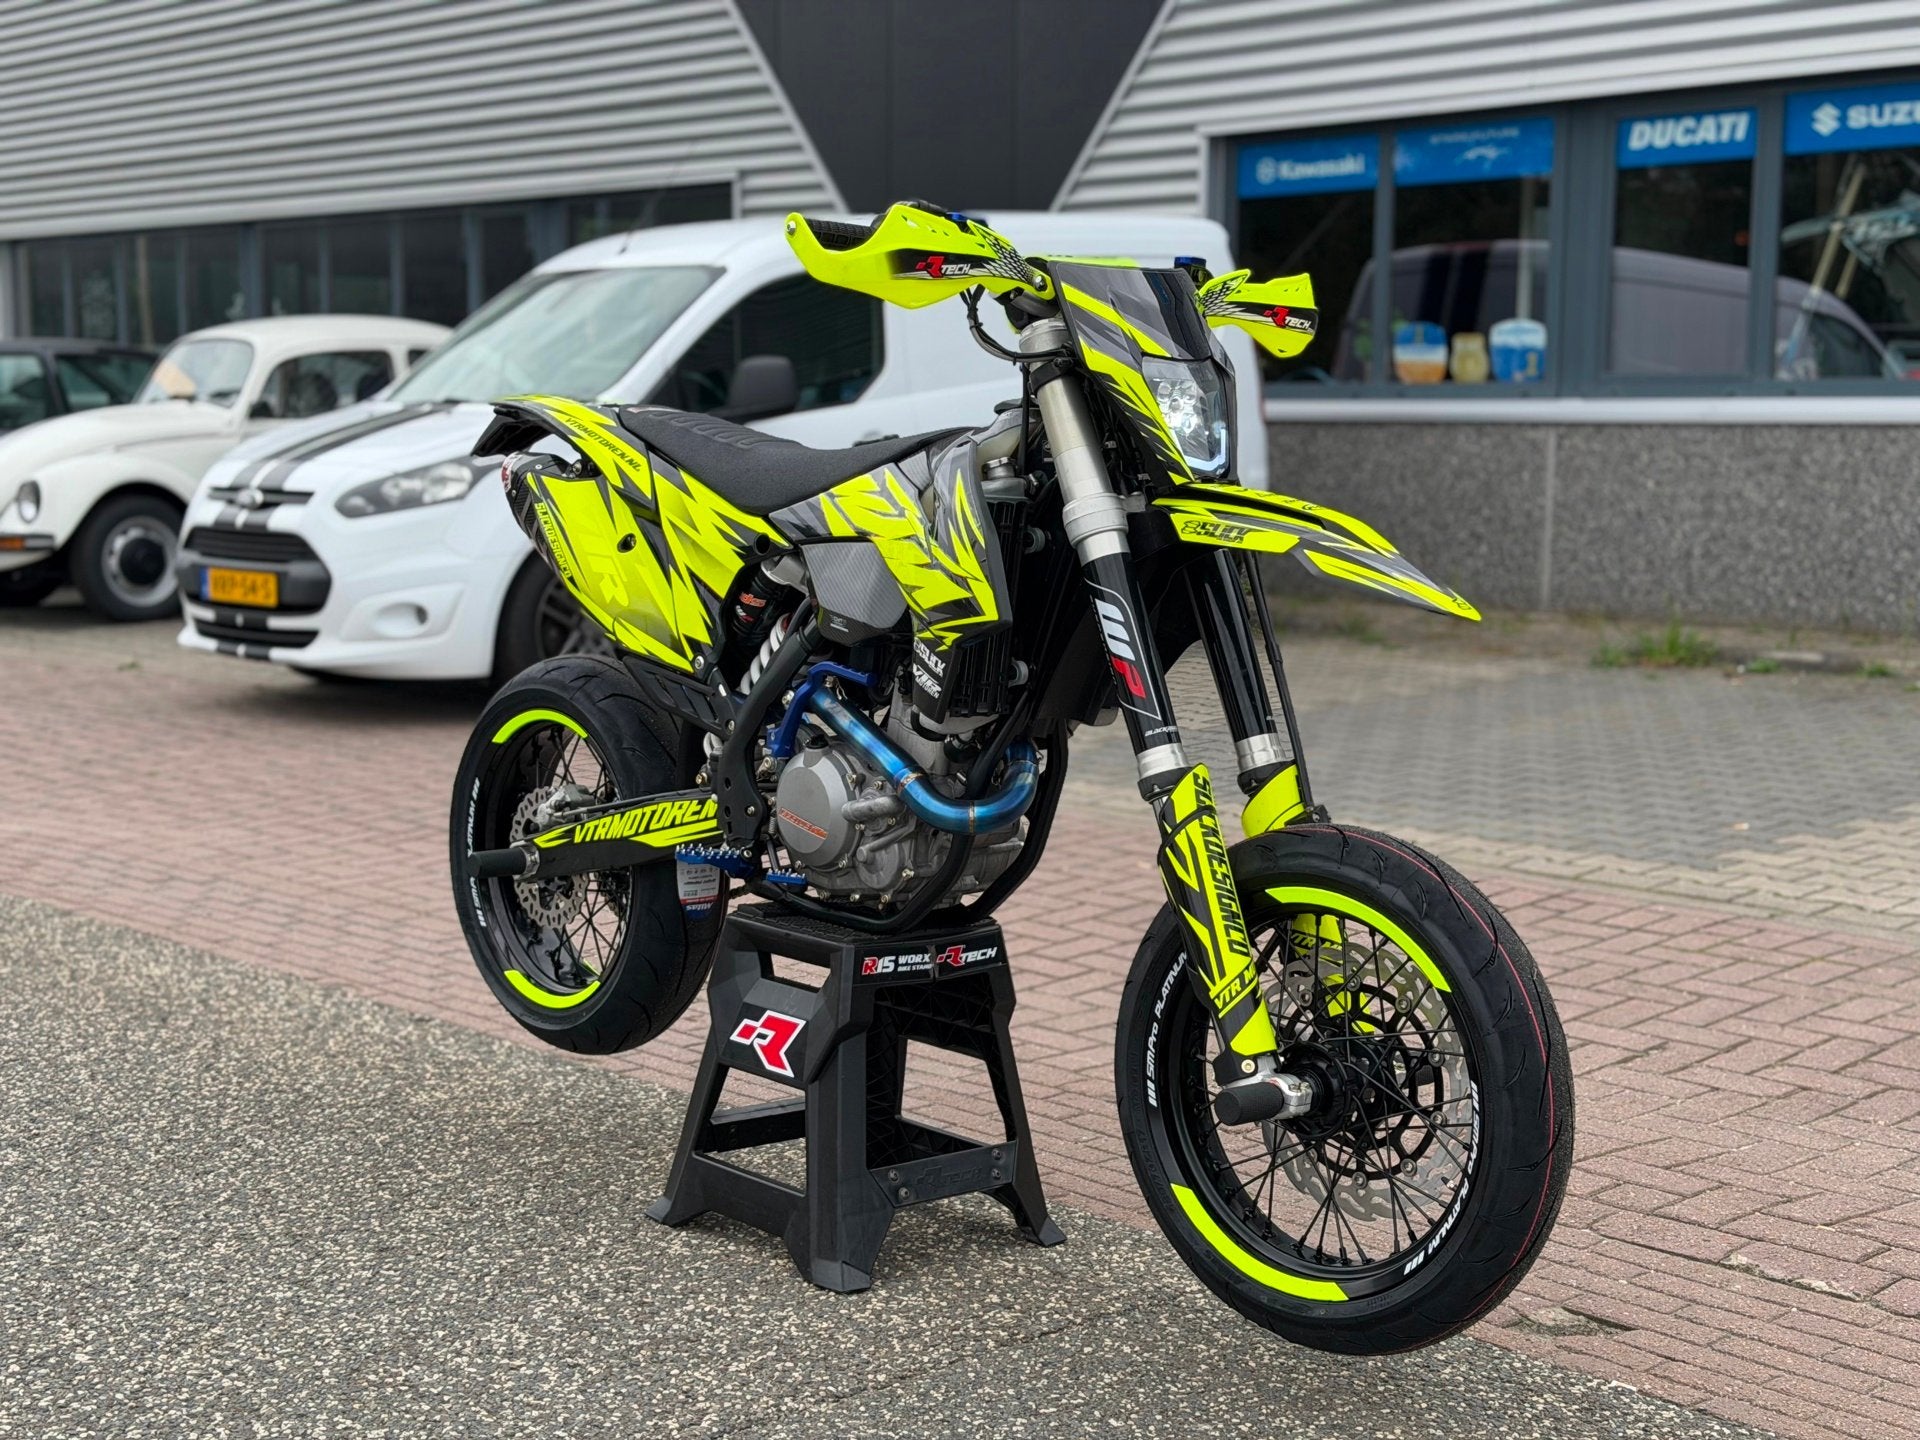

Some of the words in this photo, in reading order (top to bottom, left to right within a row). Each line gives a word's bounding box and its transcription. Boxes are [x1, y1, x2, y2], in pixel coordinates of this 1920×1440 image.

[1628, 111, 1750, 151] DUCATI
[1279, 153, 1366, 181] Kawasaki
[565, 417, 642, 472] VTRMOTOREN.NL
[573, 799, 718, 844] VTRMOTOREN
[1193, 772, 1250, 958] SLCKDESIGNCO
[897, 964, 912, 972] BIKE
[898, 953, 931, 965] WORX
[1214, 979, 1242, 1010] VTR
